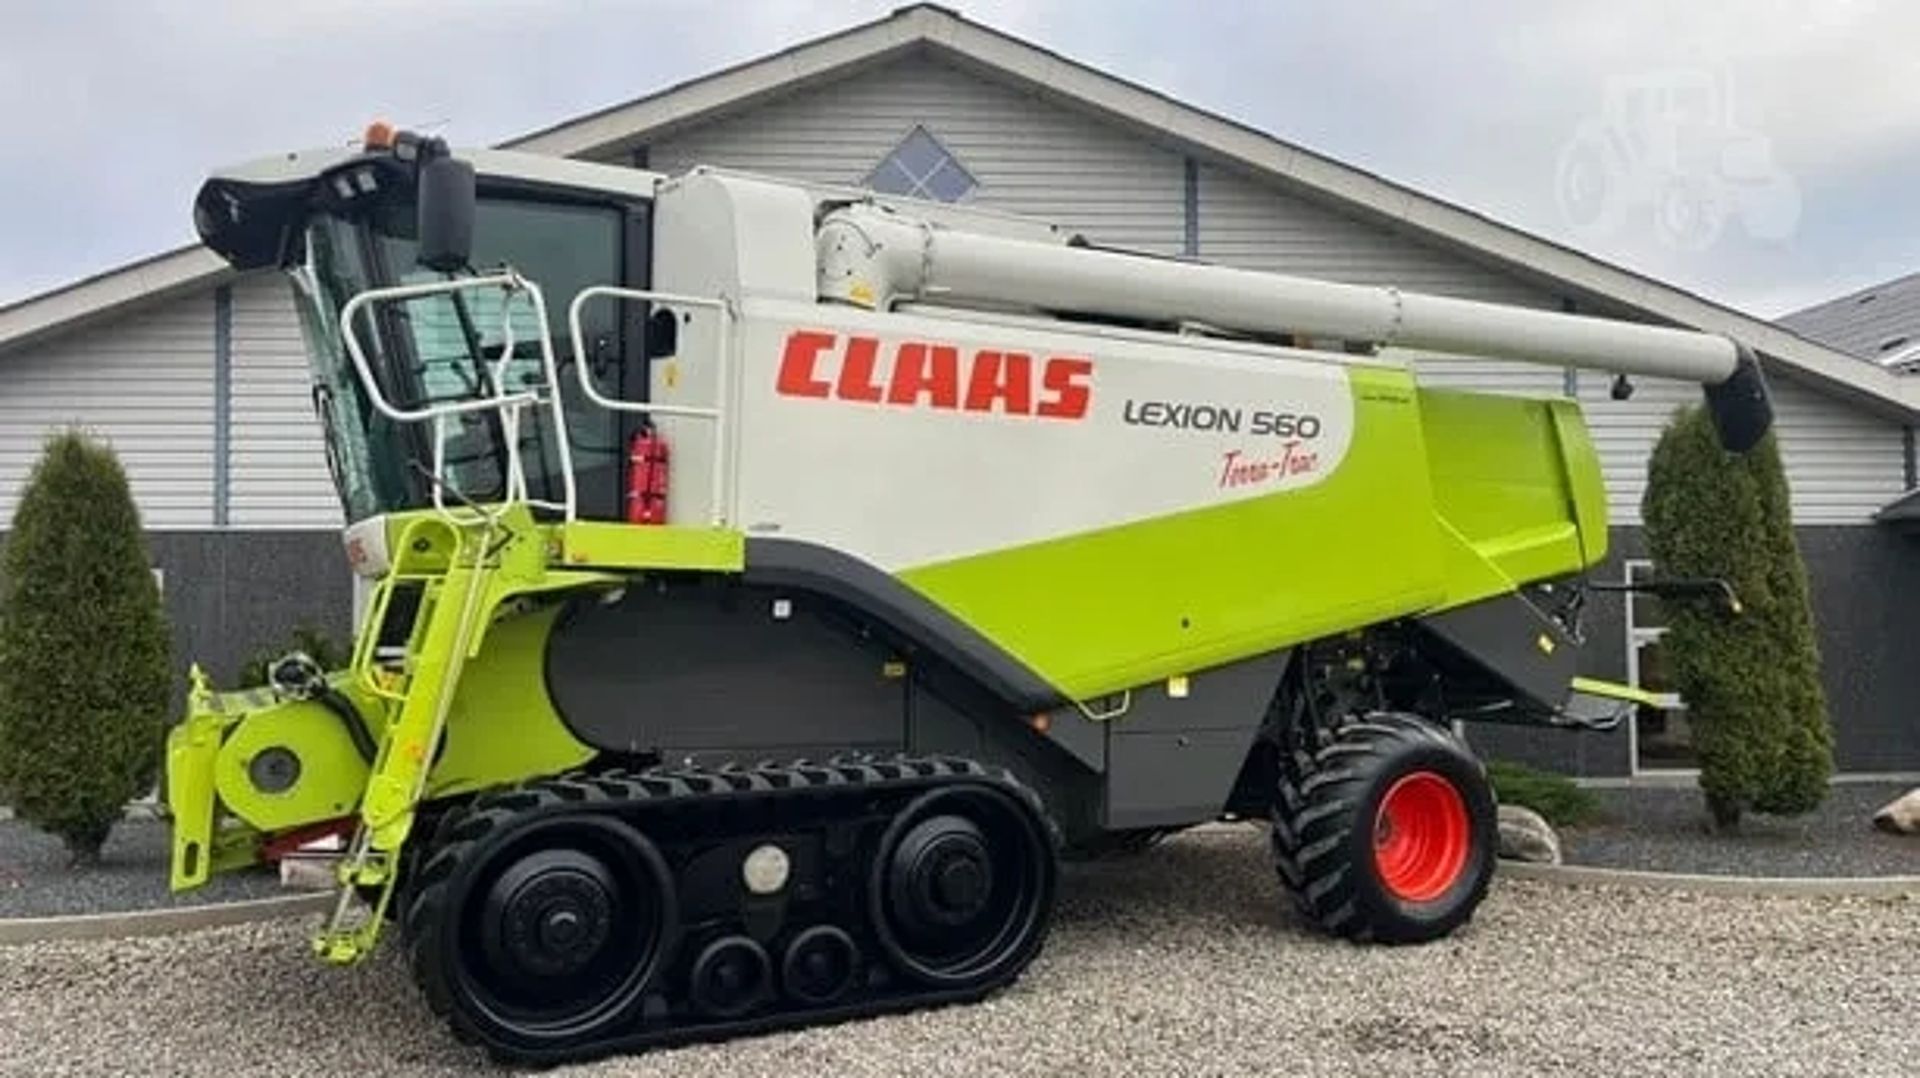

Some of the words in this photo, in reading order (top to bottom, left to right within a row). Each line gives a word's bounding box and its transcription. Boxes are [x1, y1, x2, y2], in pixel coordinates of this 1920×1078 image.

[775, 330, 1092, 420] CLAAS
[1123, 399, 1242, 432] LEXION
[1250, 411, 1321, 438] 560
